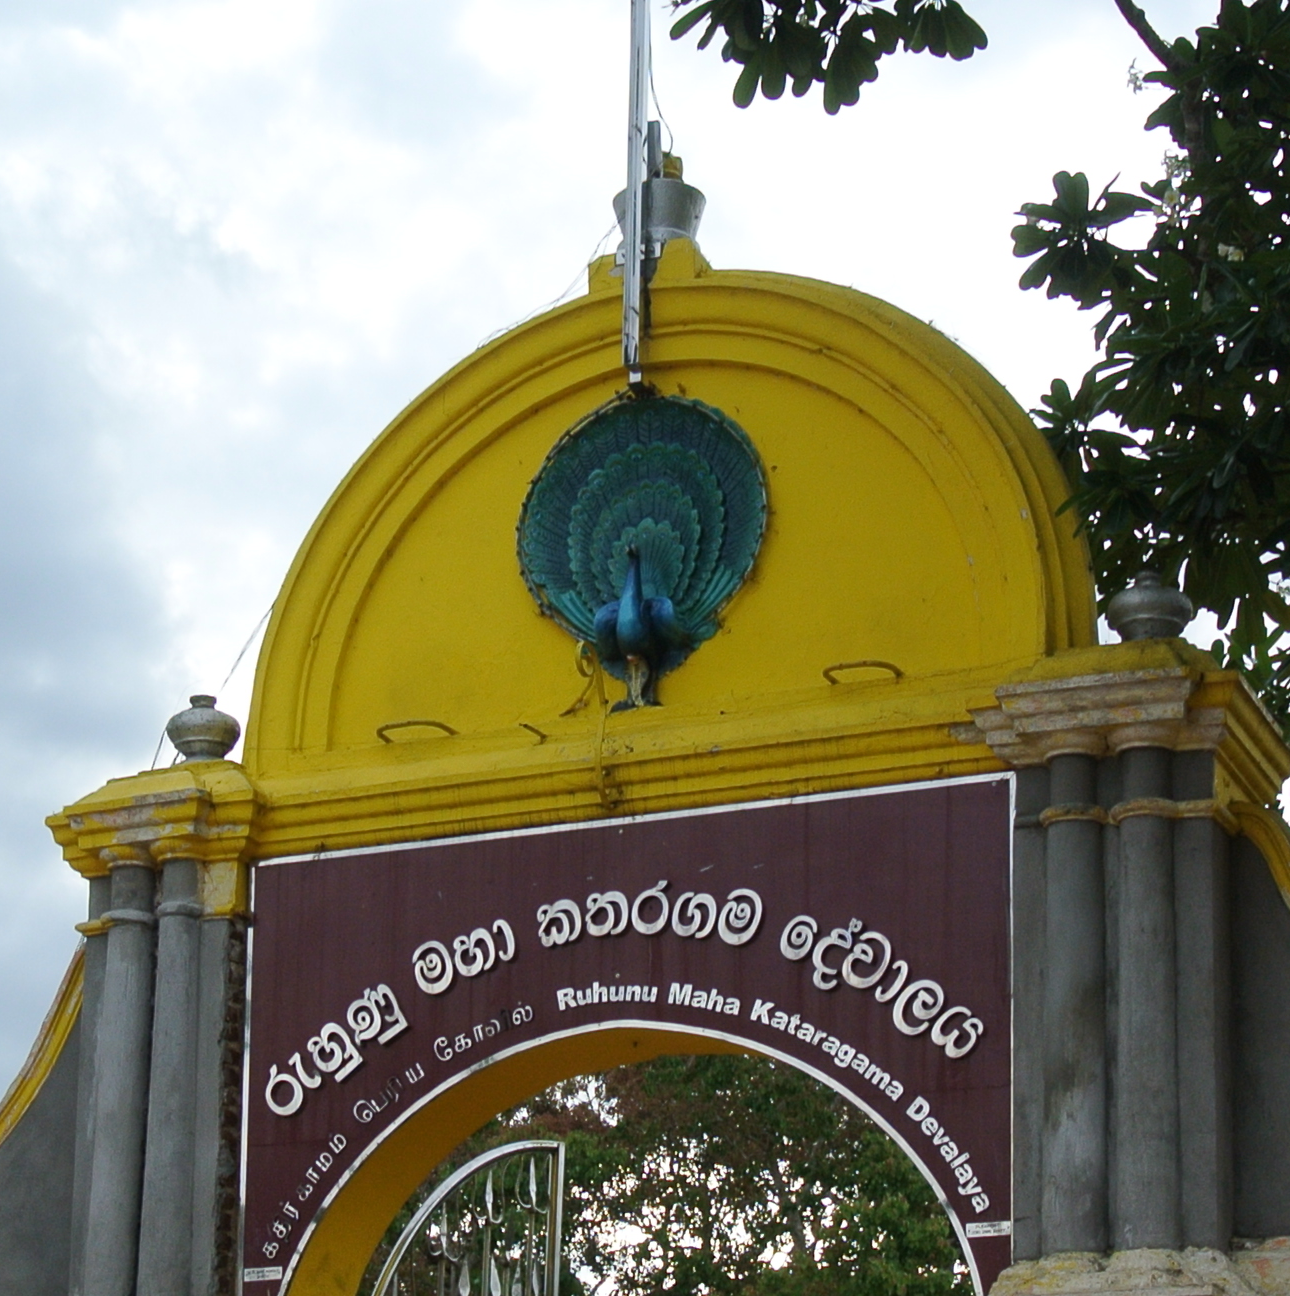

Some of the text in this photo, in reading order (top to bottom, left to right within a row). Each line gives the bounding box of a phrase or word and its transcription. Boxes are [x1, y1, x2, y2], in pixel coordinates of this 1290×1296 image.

[265, 880, 984, 1115] රුහුණු මහා කතරගම දේවාලය
[556, 981, 990, 1214] Ruhunu Maha Kataragama Devalaya
